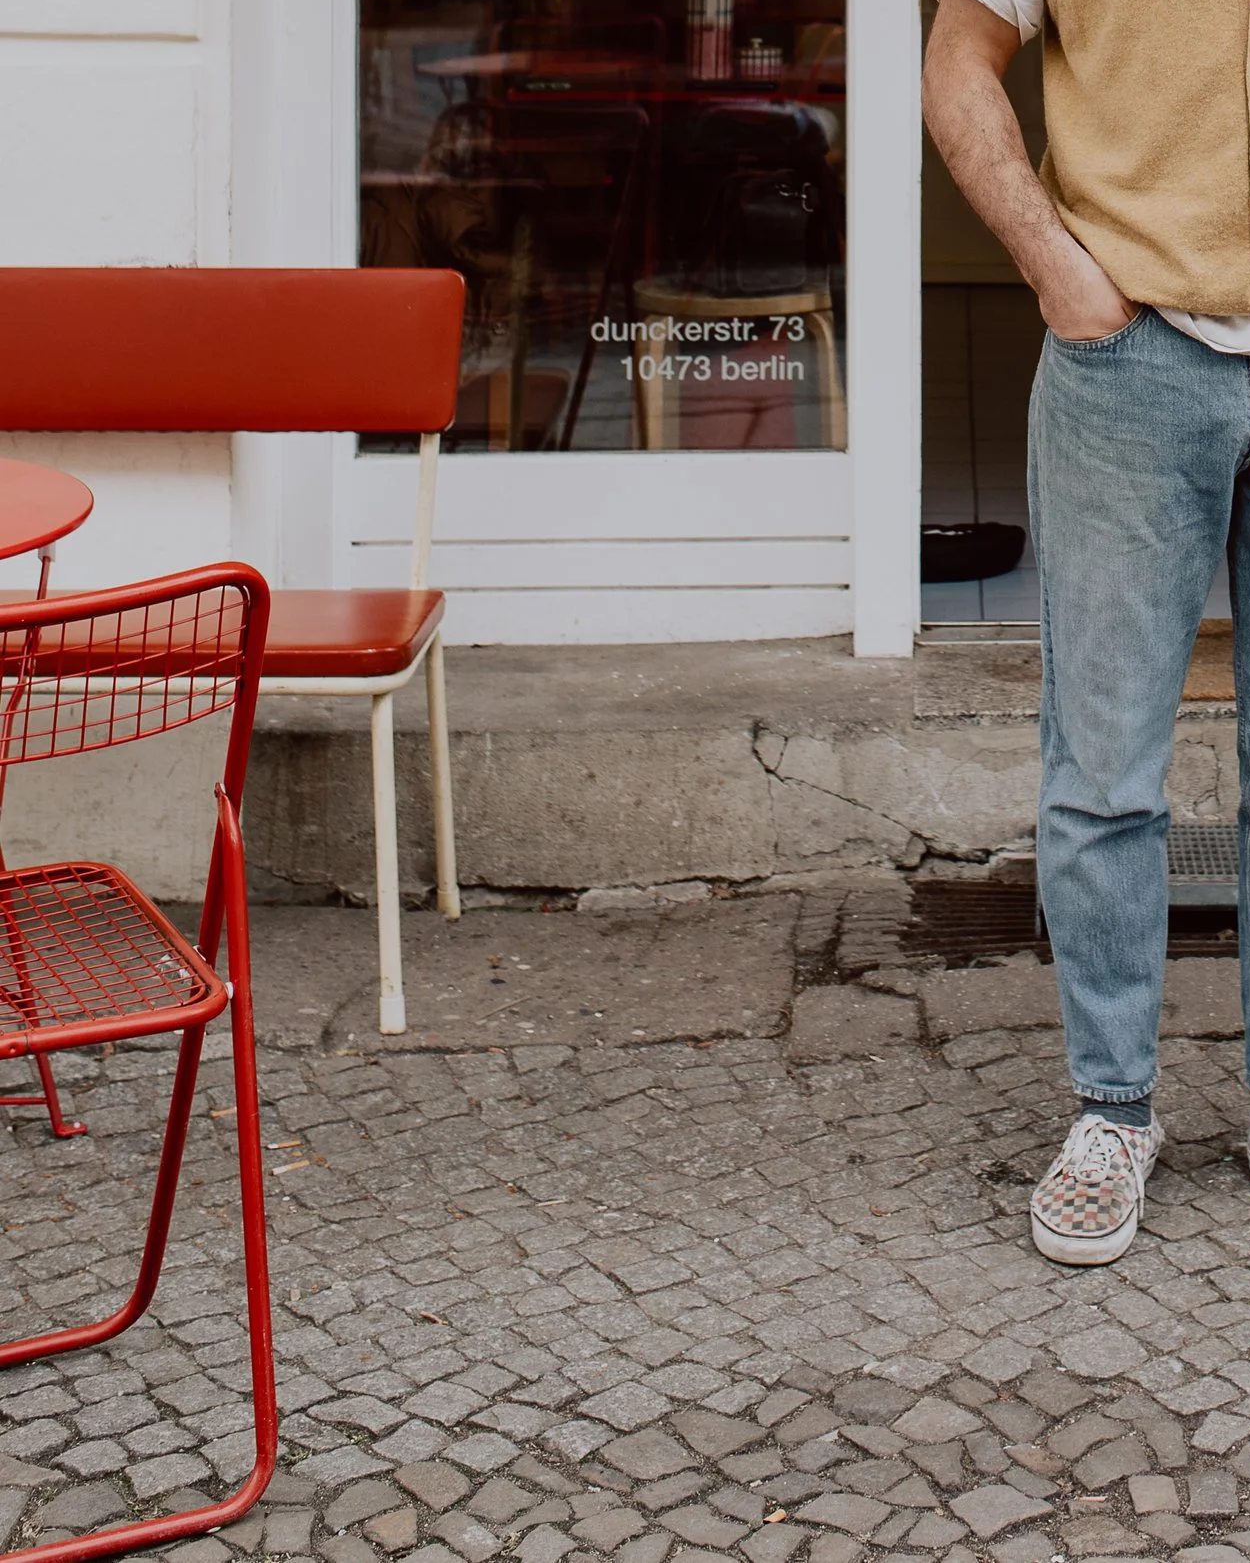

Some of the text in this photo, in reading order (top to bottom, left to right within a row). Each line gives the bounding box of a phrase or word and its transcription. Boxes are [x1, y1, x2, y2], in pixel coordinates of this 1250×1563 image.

[591, 316, 805, 342] dunckerstr. 73
[620, 355, 805, 381] 10473 berlin
